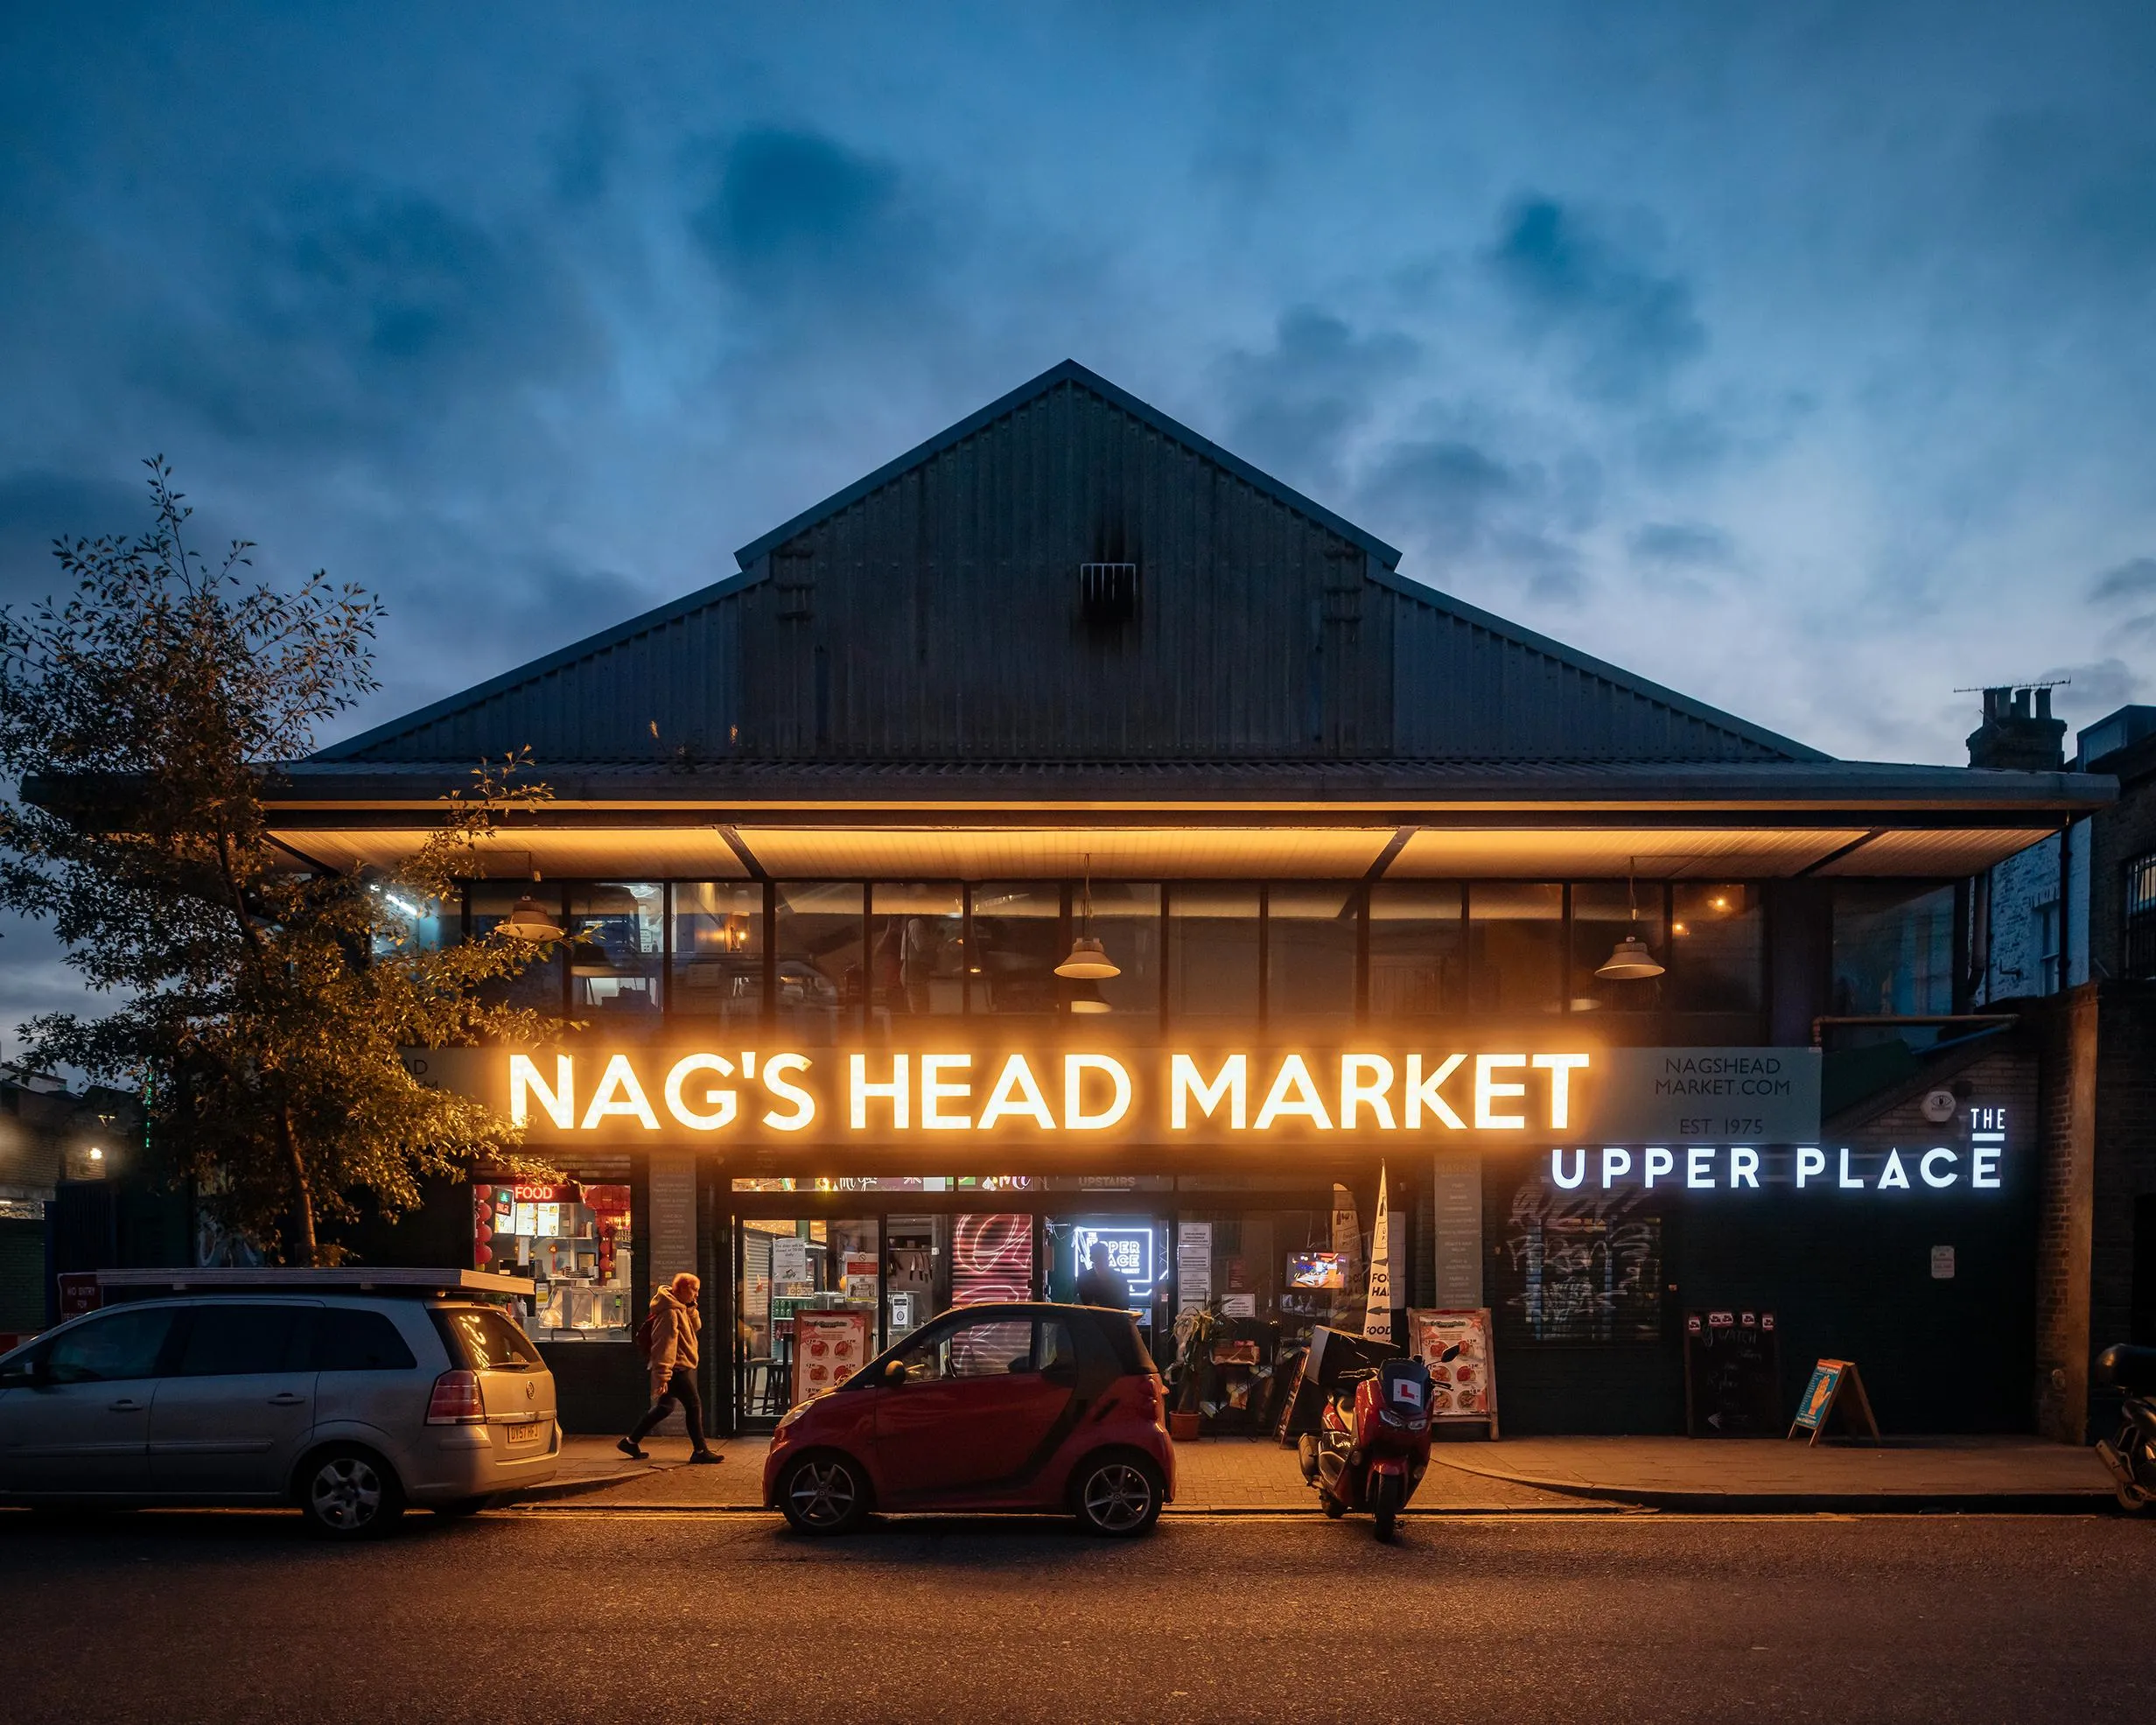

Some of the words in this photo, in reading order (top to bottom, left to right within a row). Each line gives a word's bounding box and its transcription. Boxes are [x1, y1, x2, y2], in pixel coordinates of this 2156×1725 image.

[1665, 1058, 1782, 1074] NAGSHEAD
[509, 1051, 816, 1131] NAG'S
[850, 1054, 1131, 1129] HEAD
[1171, 1053, 1590, 1129] MARKET
[1656, 1078, 1790, 1095] MARKET.COM
[1725, 1118, 1763, 1135] 1975
[1970, 1108, 2006, 1129] THE
[1551, 1147, 1760, 1189] UPPER
[1796, 1146, 2002, 1189] PLACE
[514, 1187, 553, 1199] FOOD
[1401, 1385, 1415, 1399] L
